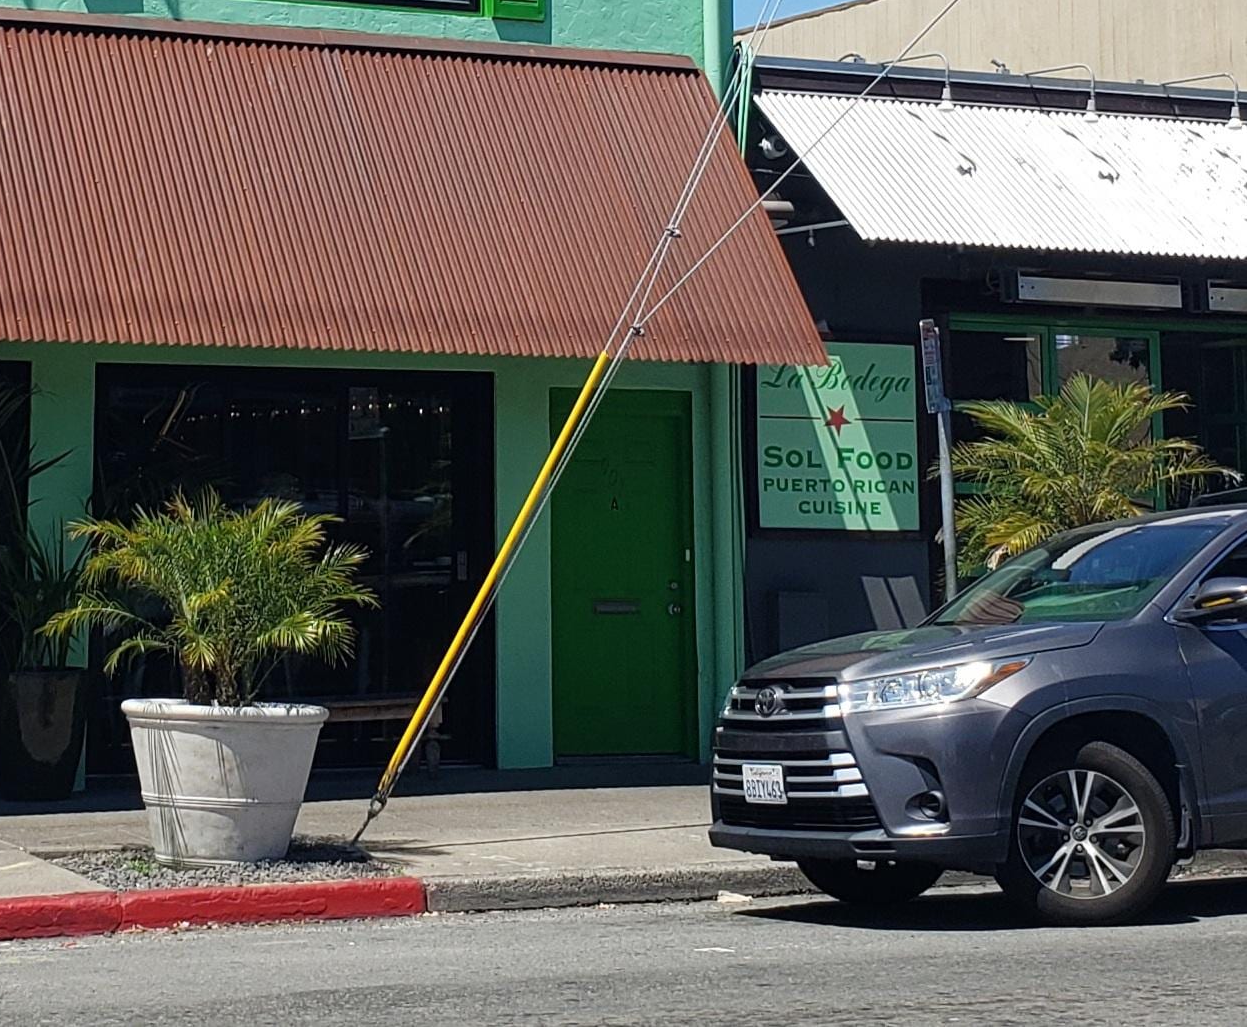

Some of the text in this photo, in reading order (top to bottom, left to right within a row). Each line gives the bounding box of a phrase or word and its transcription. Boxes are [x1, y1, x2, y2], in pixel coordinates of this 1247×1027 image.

[761, 359, 910, 402] La Bodega
[763, 446, 913, 470] SOL FOOD
[763, 478, 915, 494] PUERTO RICAN
[798, 500, 881, 515] CUISINE
